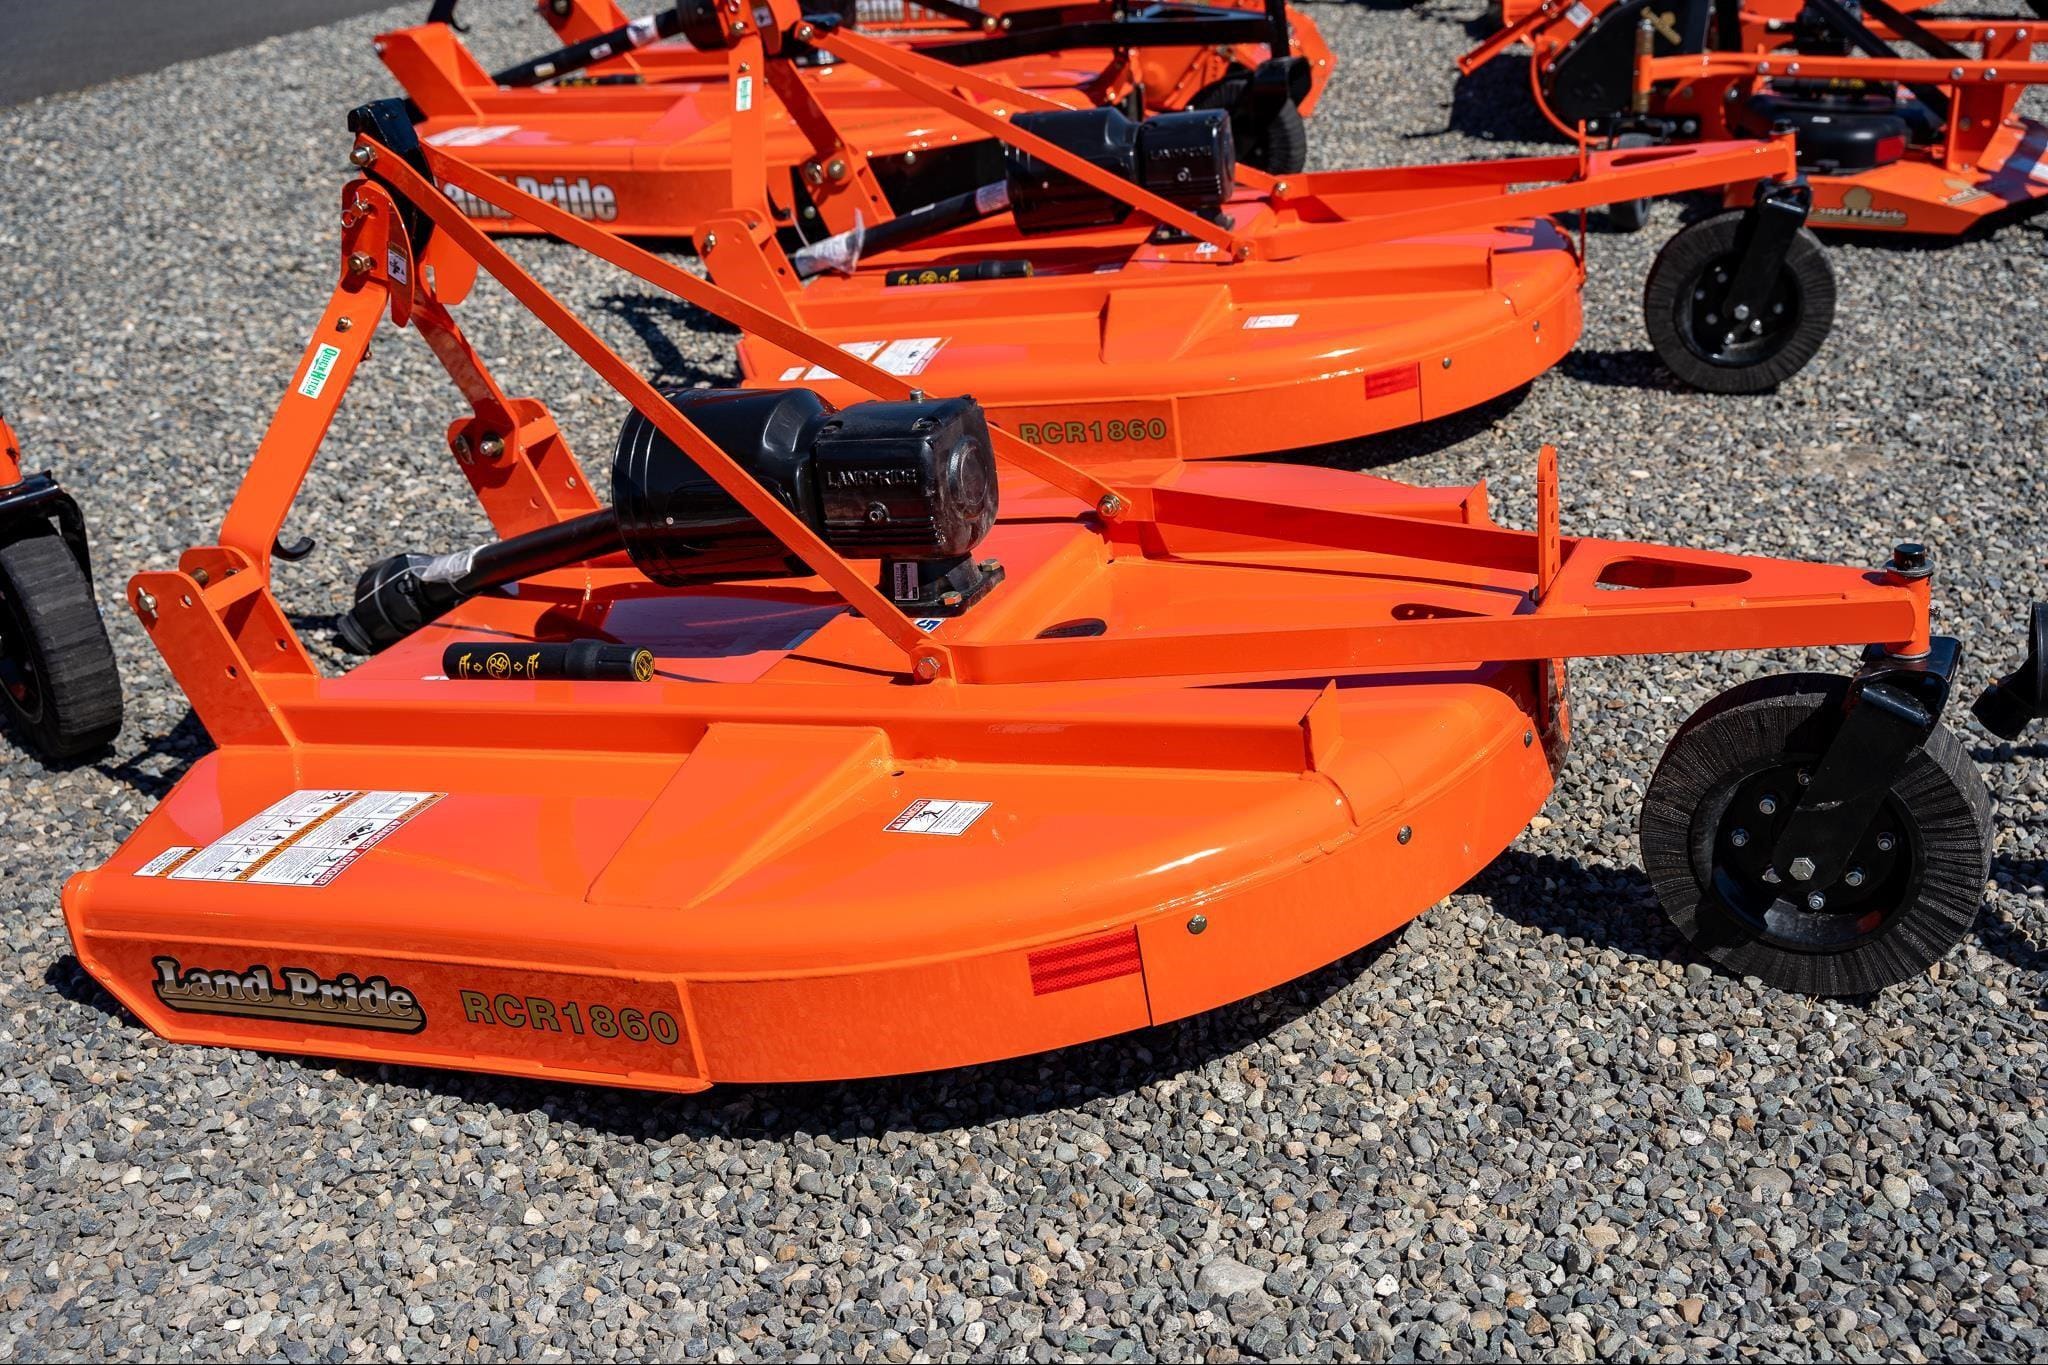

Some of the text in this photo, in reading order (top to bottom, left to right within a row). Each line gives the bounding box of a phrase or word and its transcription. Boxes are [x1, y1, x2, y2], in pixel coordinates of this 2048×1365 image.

[1019, 417, 1167, 445] RCR1860
[895, 801, 928, 822] DANGER
[355, 823, 400, 849] DANGER
[309, 855, 360, 884] DANGER
[156, 959, 415, 1017] Land Pride
[459, 989, 680, 1045] RCR1860
